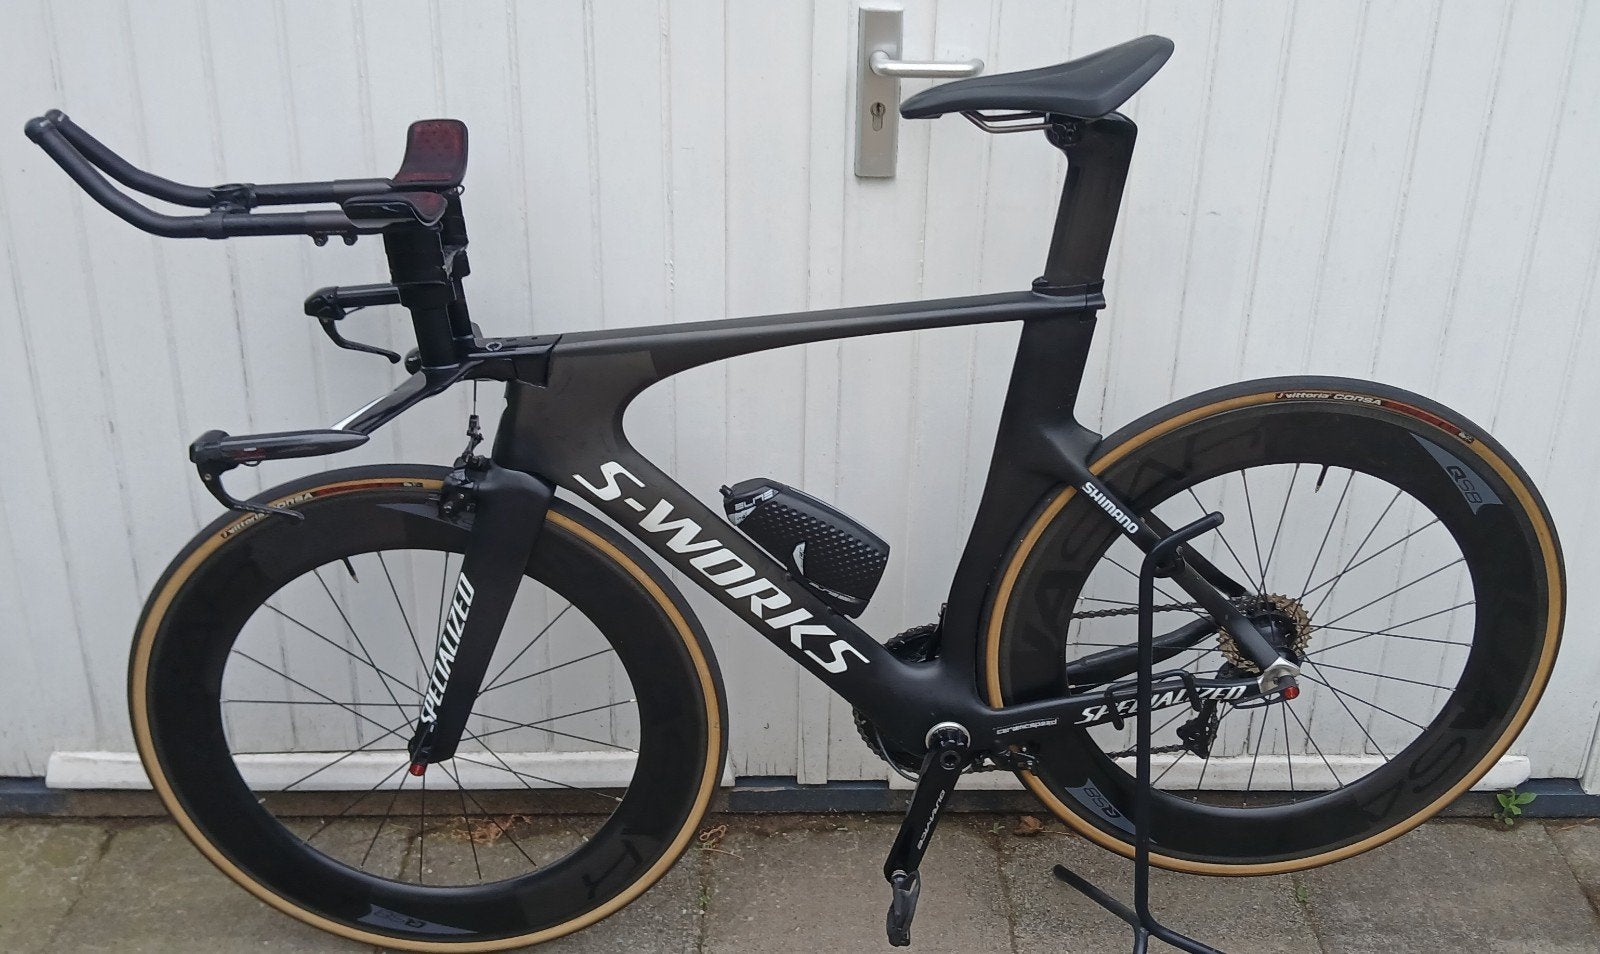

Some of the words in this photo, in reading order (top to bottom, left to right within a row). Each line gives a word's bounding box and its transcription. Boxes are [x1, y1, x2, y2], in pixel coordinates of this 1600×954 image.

[1285, 391, 1330, 400] vittoria
[1333, 392, 1382, 406] CORSA
[1081, 481, 1139, 534] SHIMANO
[572, 460, 871, 674] S-WORKS
[419, 571, 475, 732] SPECIALIZED
